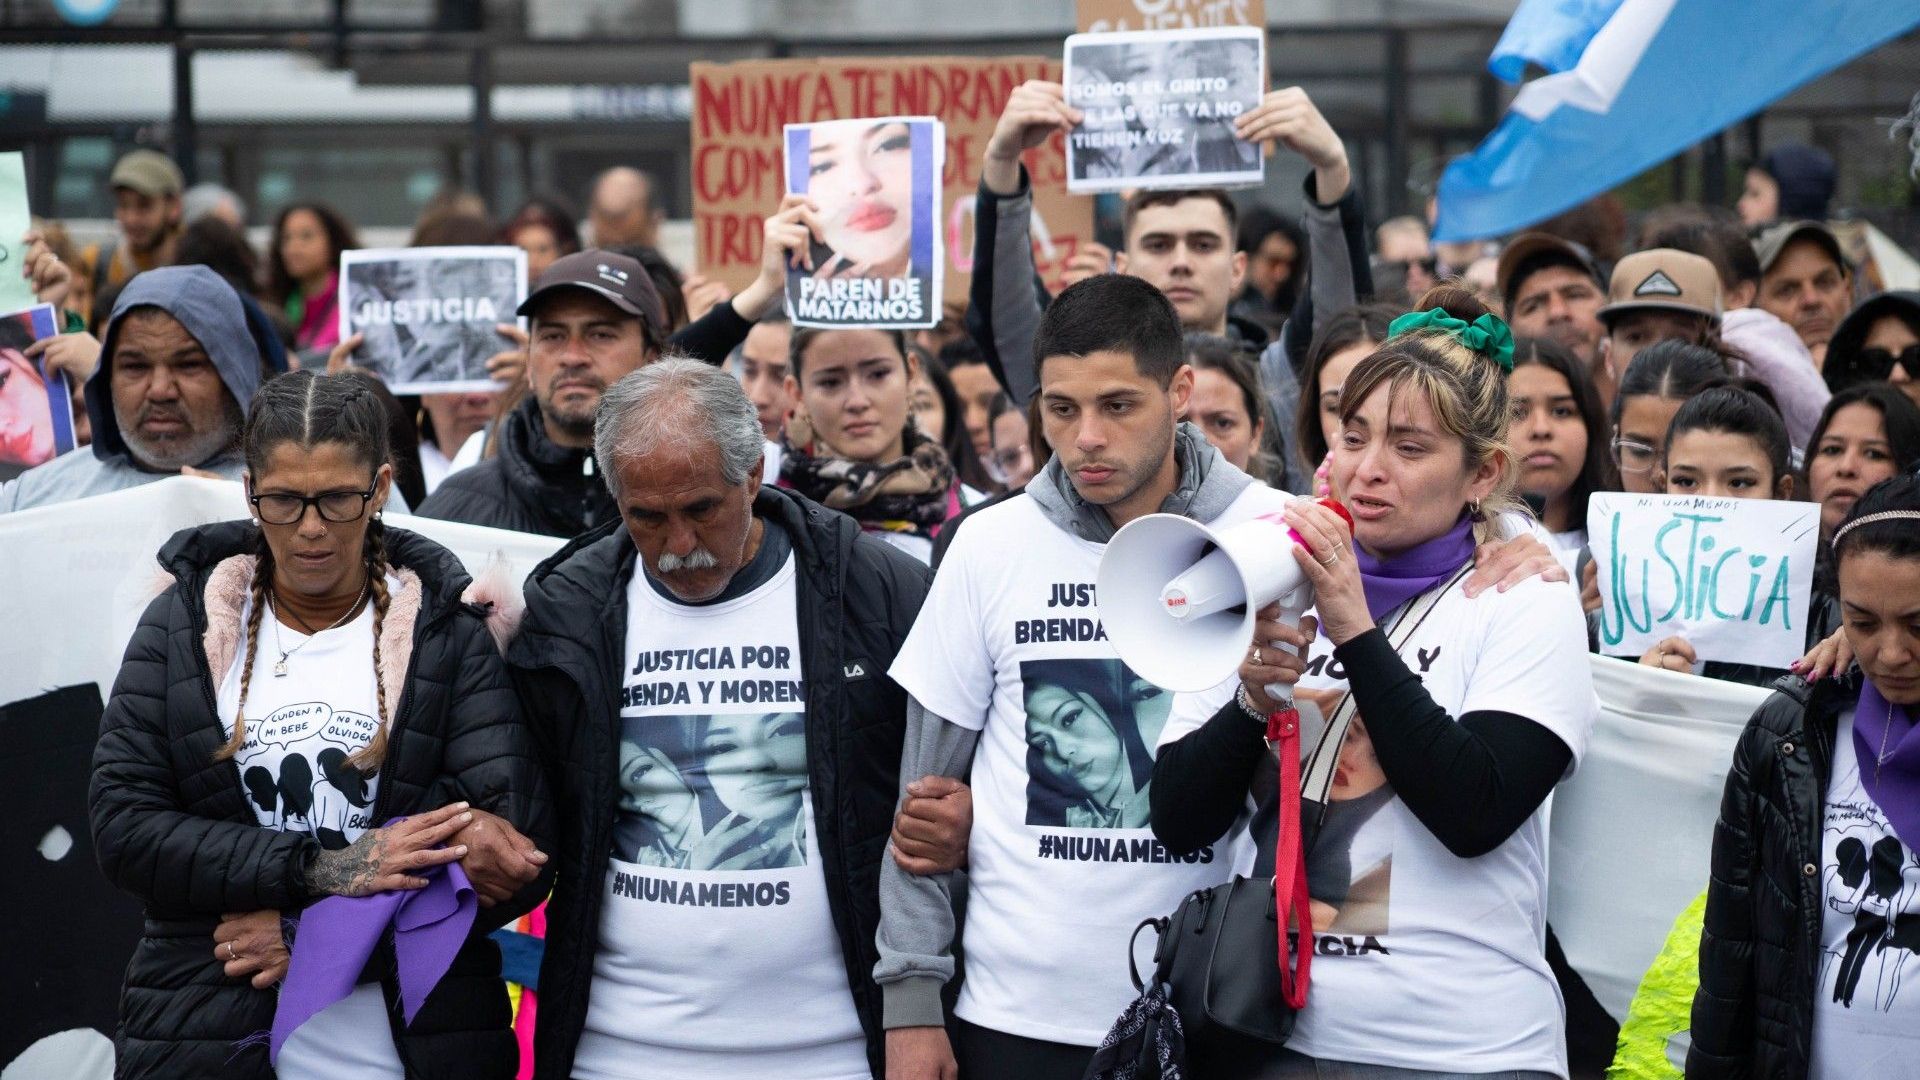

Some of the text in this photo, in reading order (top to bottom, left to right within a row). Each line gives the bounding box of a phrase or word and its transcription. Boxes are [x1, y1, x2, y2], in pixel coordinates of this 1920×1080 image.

[1072, 77, 1229, 98] SOMOS EL GRITO
[1184, 102, 1209, 118] YA
[1214, 100, 1245, 117] NO
[1073, 128, 1185, 148] TIENEN VOZ
[799, 277, 921, 300] PAREN DE
[352, 296, 498, 327] JUSTICIA
[798, 298, 924, 320] MATARNOS
[1015, 618, 1109, 645] BRENDA
[632, 646, 790, 675] JUSTICIA POR
[620, 680, 805, 709] RENDA Y MOREN
[271, 706, 323, 723] CUIDEN A
[336, 715, 374, 731] NO NOS
[265, 721, 309, 737] MI BEBE
[612, 871, 791, 908] #NIUNAMENOS
